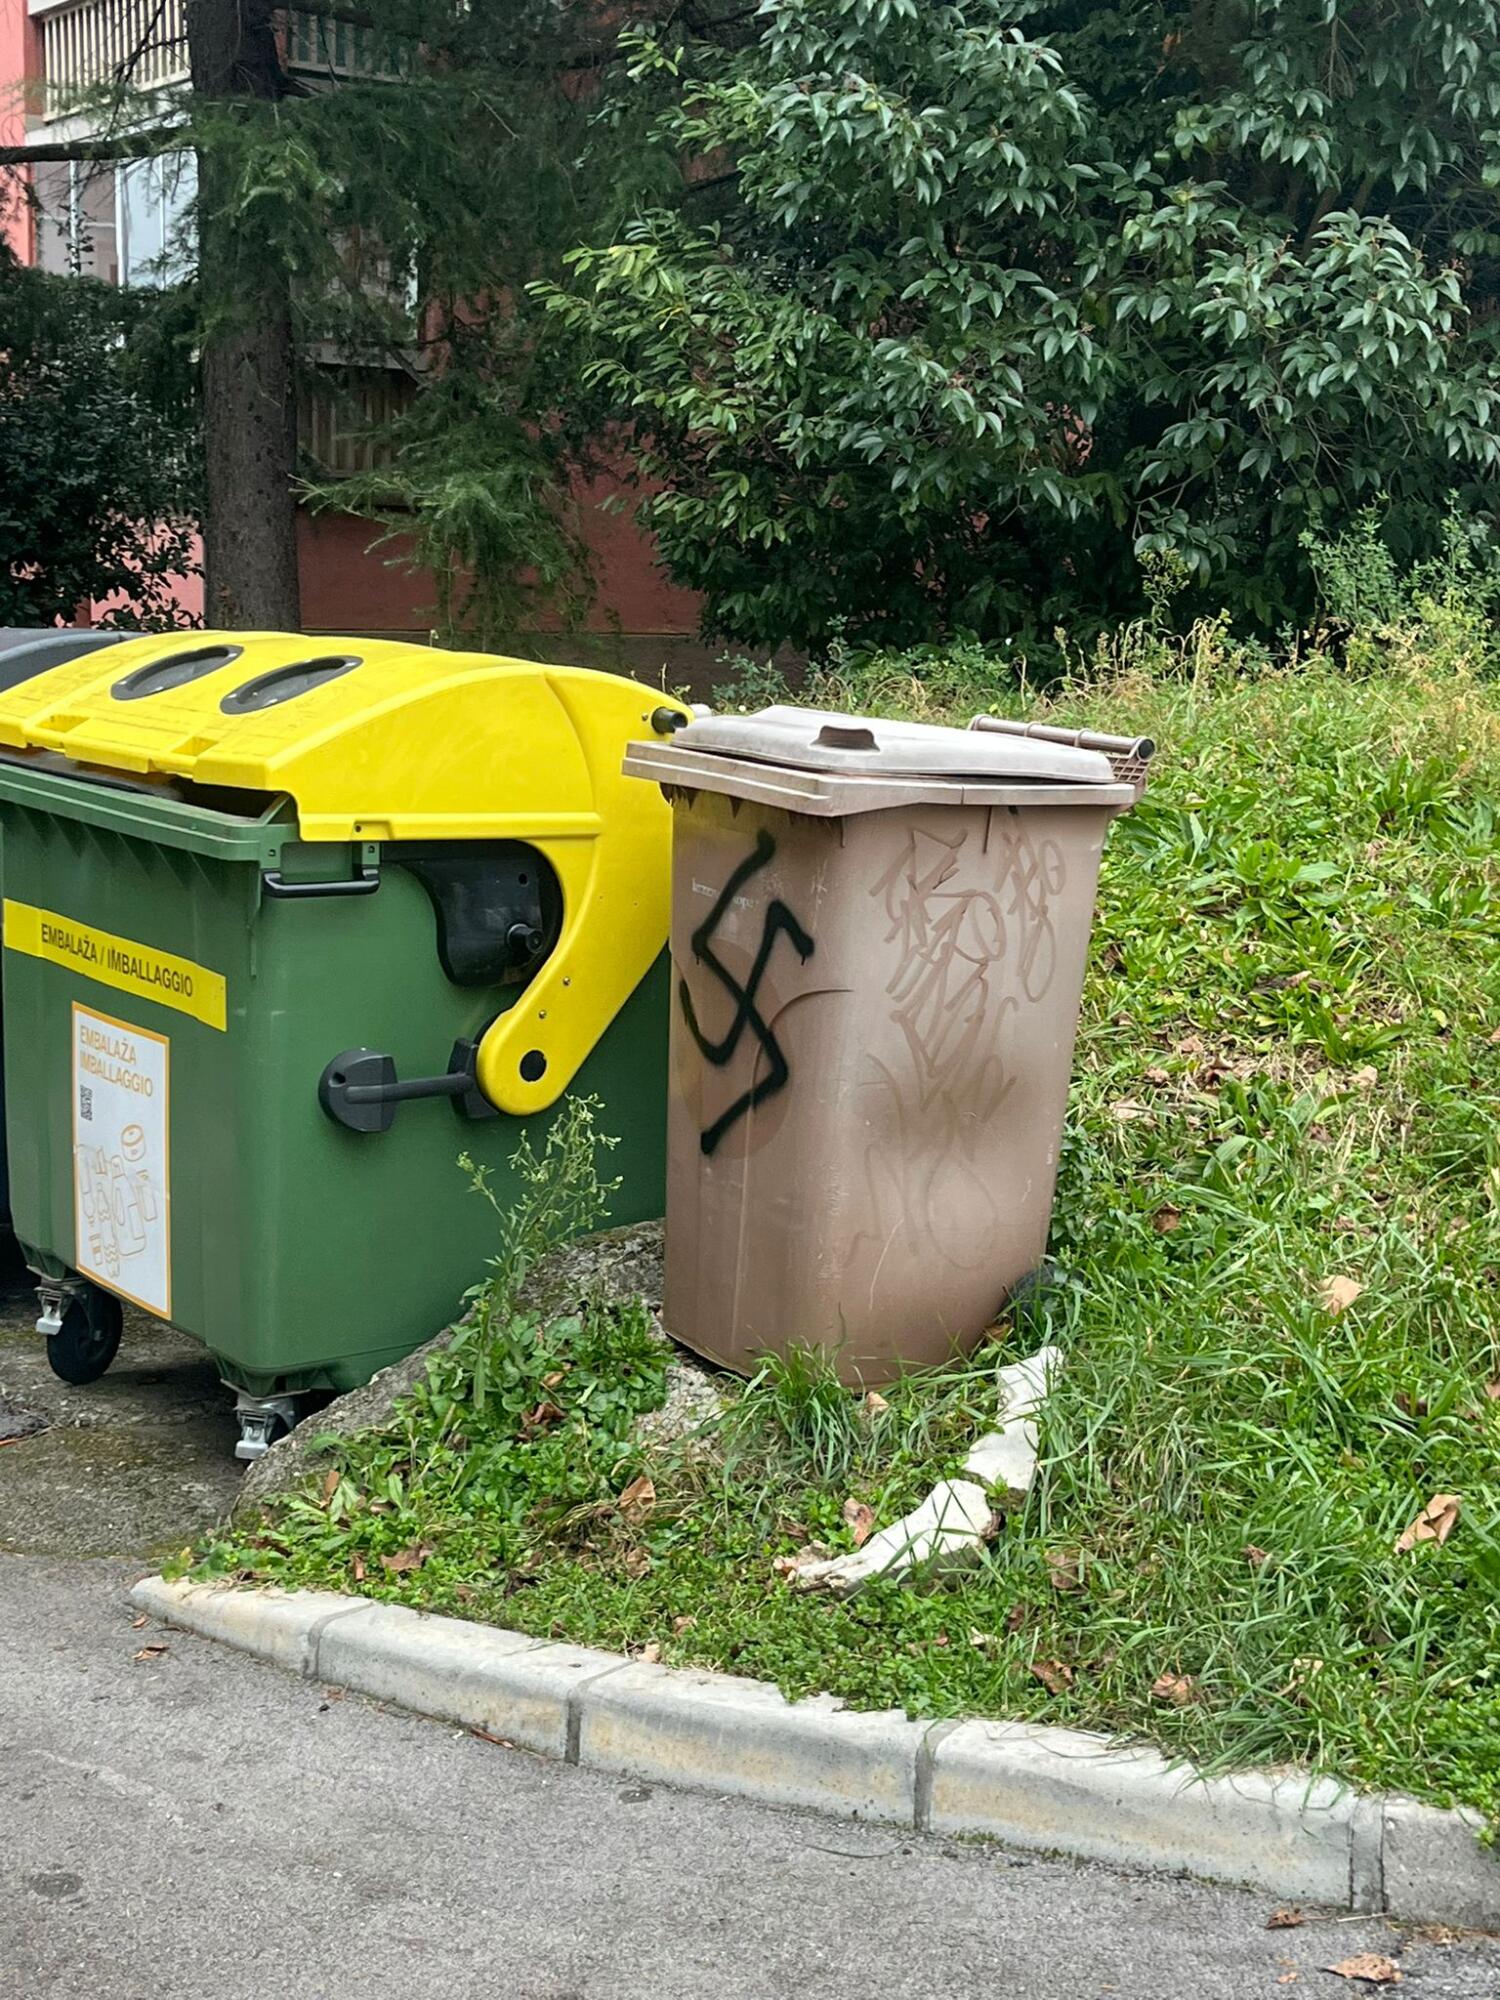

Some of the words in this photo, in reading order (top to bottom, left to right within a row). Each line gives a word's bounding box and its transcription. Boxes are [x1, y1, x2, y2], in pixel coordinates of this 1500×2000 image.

[41, 923, 97, 963] EMBALAŽA
[99, 946, 105, 966] /
[107, 947, 193, 997] IMBALLAGGIO
[80, 1025, 136, 1065] EMBALAŽA
[80, 1051, 153, 1096] IMBALLAGGIO
